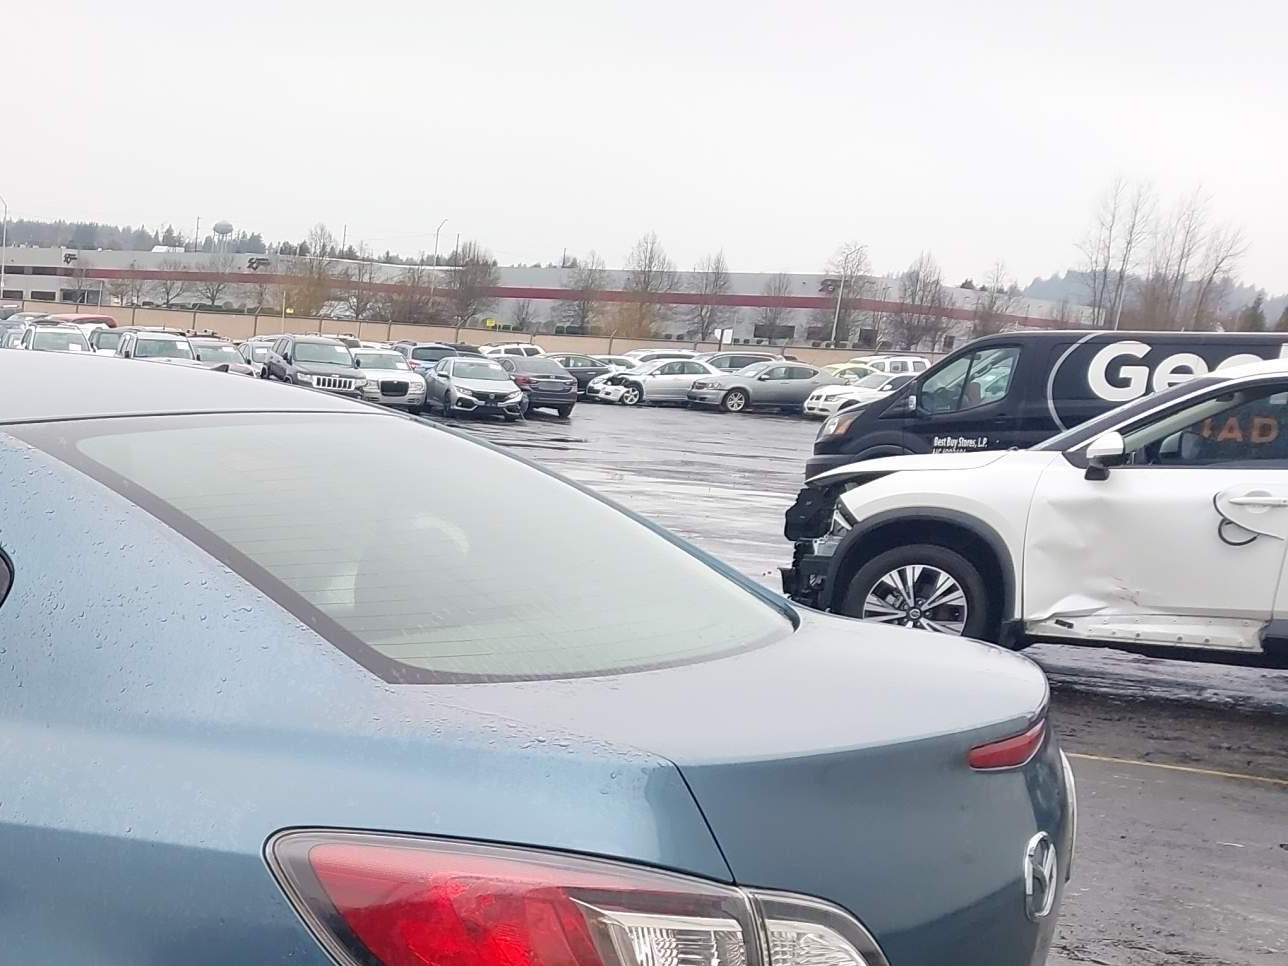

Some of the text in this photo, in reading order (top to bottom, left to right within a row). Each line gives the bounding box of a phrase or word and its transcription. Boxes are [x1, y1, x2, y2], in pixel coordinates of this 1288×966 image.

[1088, 341, 1288, 401] Ge
[934, 436, 946, 447] Best
[947, 437, 958, 449] Buy
